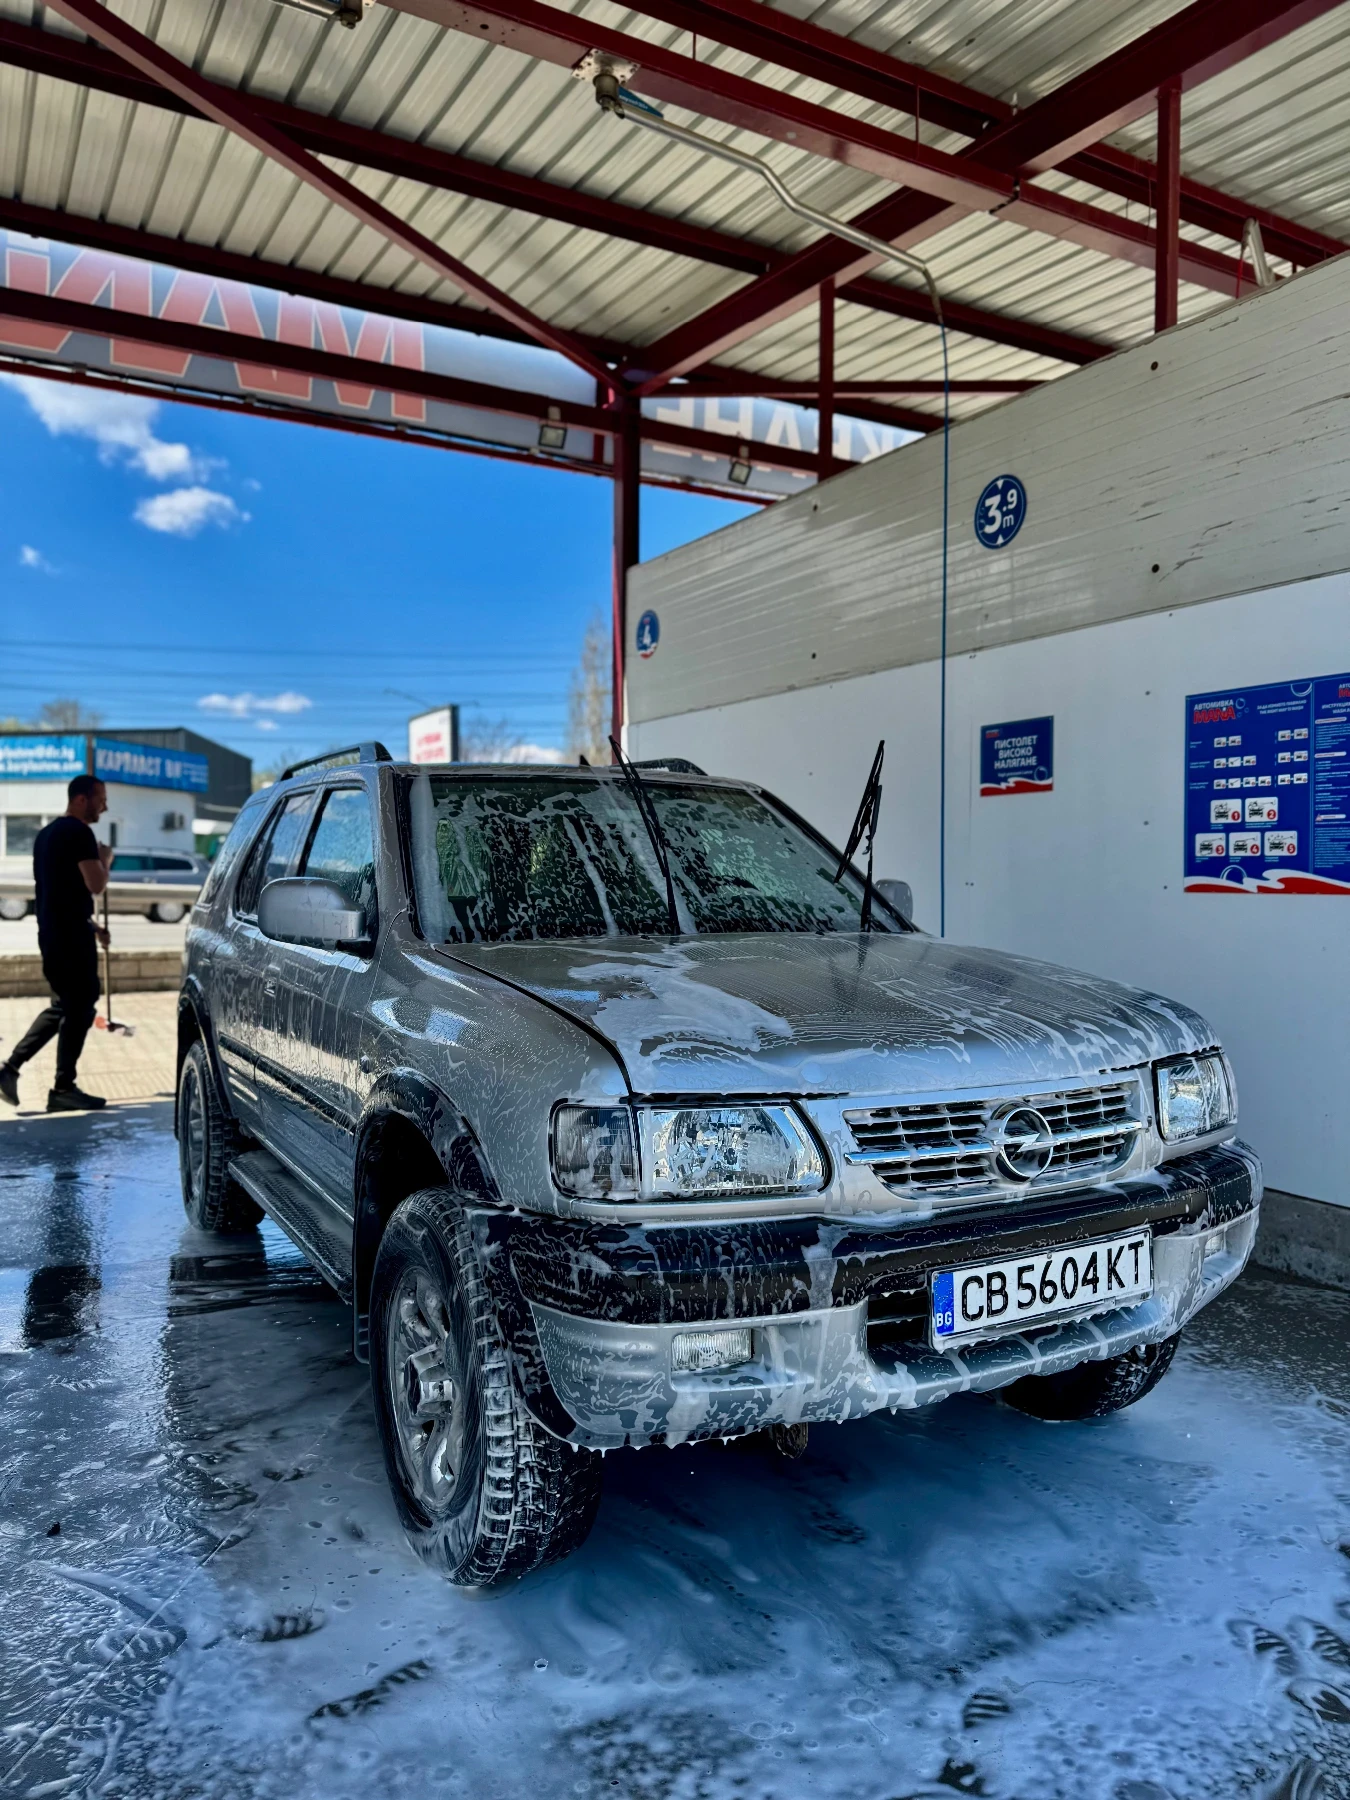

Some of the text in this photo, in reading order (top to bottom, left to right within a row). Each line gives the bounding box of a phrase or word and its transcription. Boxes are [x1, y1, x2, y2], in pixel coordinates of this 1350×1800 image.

[1194, 699, 1234, 711] АВТОМИВКА
[994, 734, 1038, 750] ПИСТОЛЕТ
[998, 746, 1033, 759] ВИСОКО
[994, 756, 1038, 770] НАЛЯГАНЕ
[935, 1311, 954, 1329] BG
